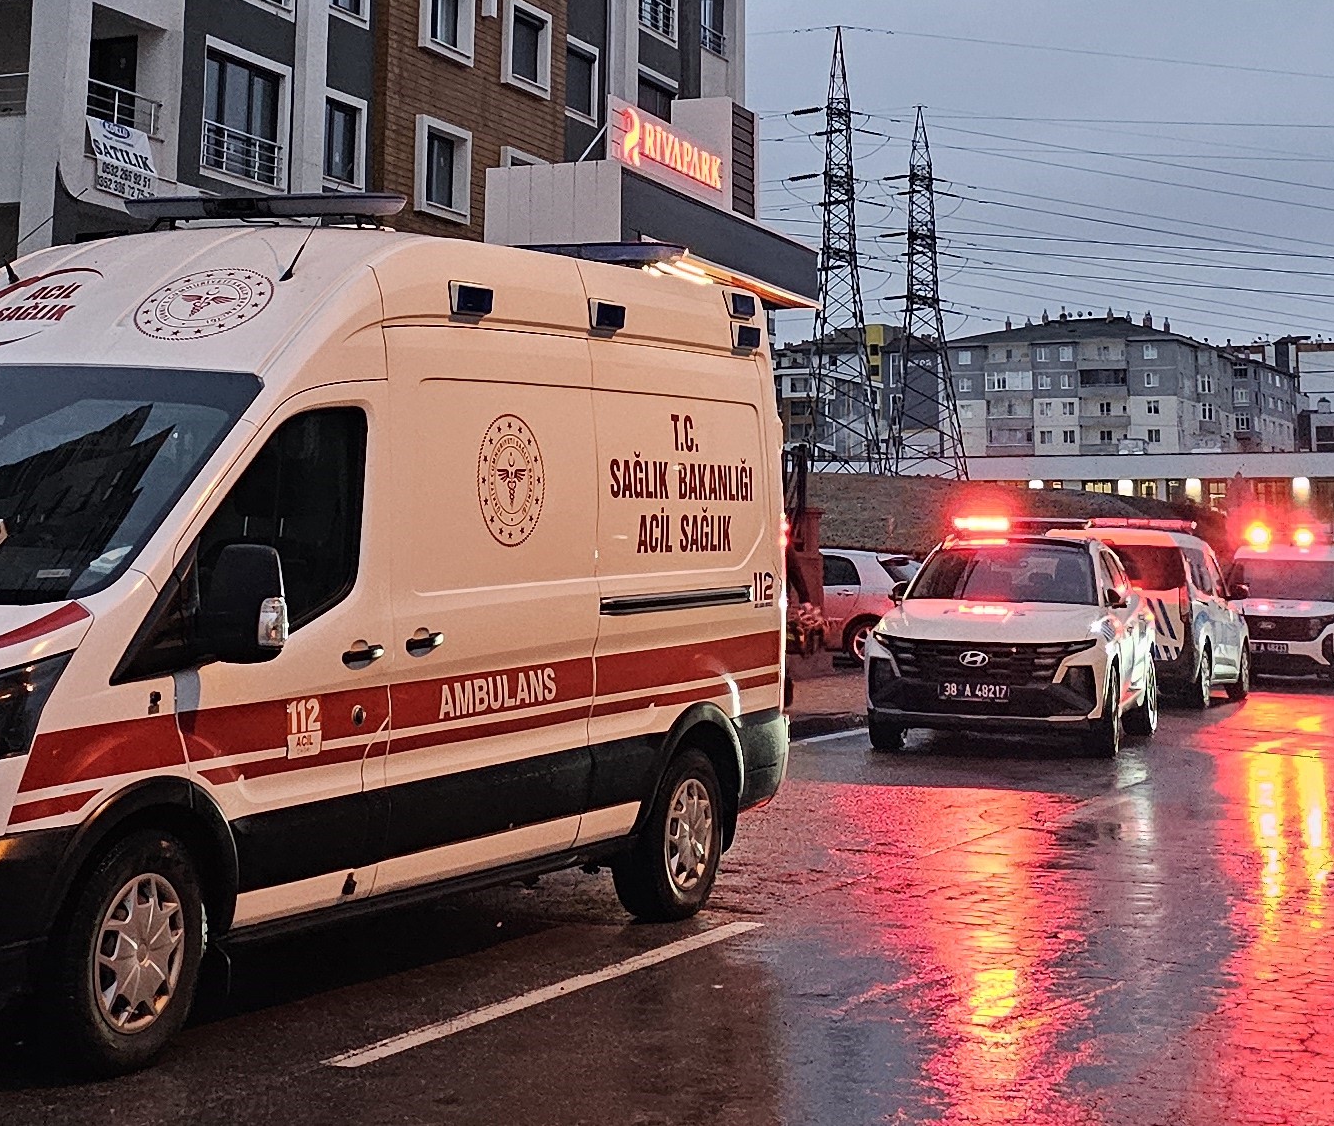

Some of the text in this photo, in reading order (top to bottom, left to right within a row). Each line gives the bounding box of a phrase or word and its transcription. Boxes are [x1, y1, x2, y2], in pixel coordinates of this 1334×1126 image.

[93, 139, 154, 173] SATILIK
[643, 122, 722, 189] RİVAPARK
[102, 162, 119, 177] 0532
[143, 177, 151, 189] 51
[23, 282, 83, 301] ACİL
[670, 414, 699, 452] T.C.
[610, 451, 753, 502] SAĞLIK BAKANLIĞI
[637, 507, 732, 554] ACİL SAĞLIK
[754, 572, 774, 601] 112
[439, 667, 557, 720] AMBULANS
[944, 682, 1007, 698] 38 A 48217
[287, 698, 321, 734] 112
